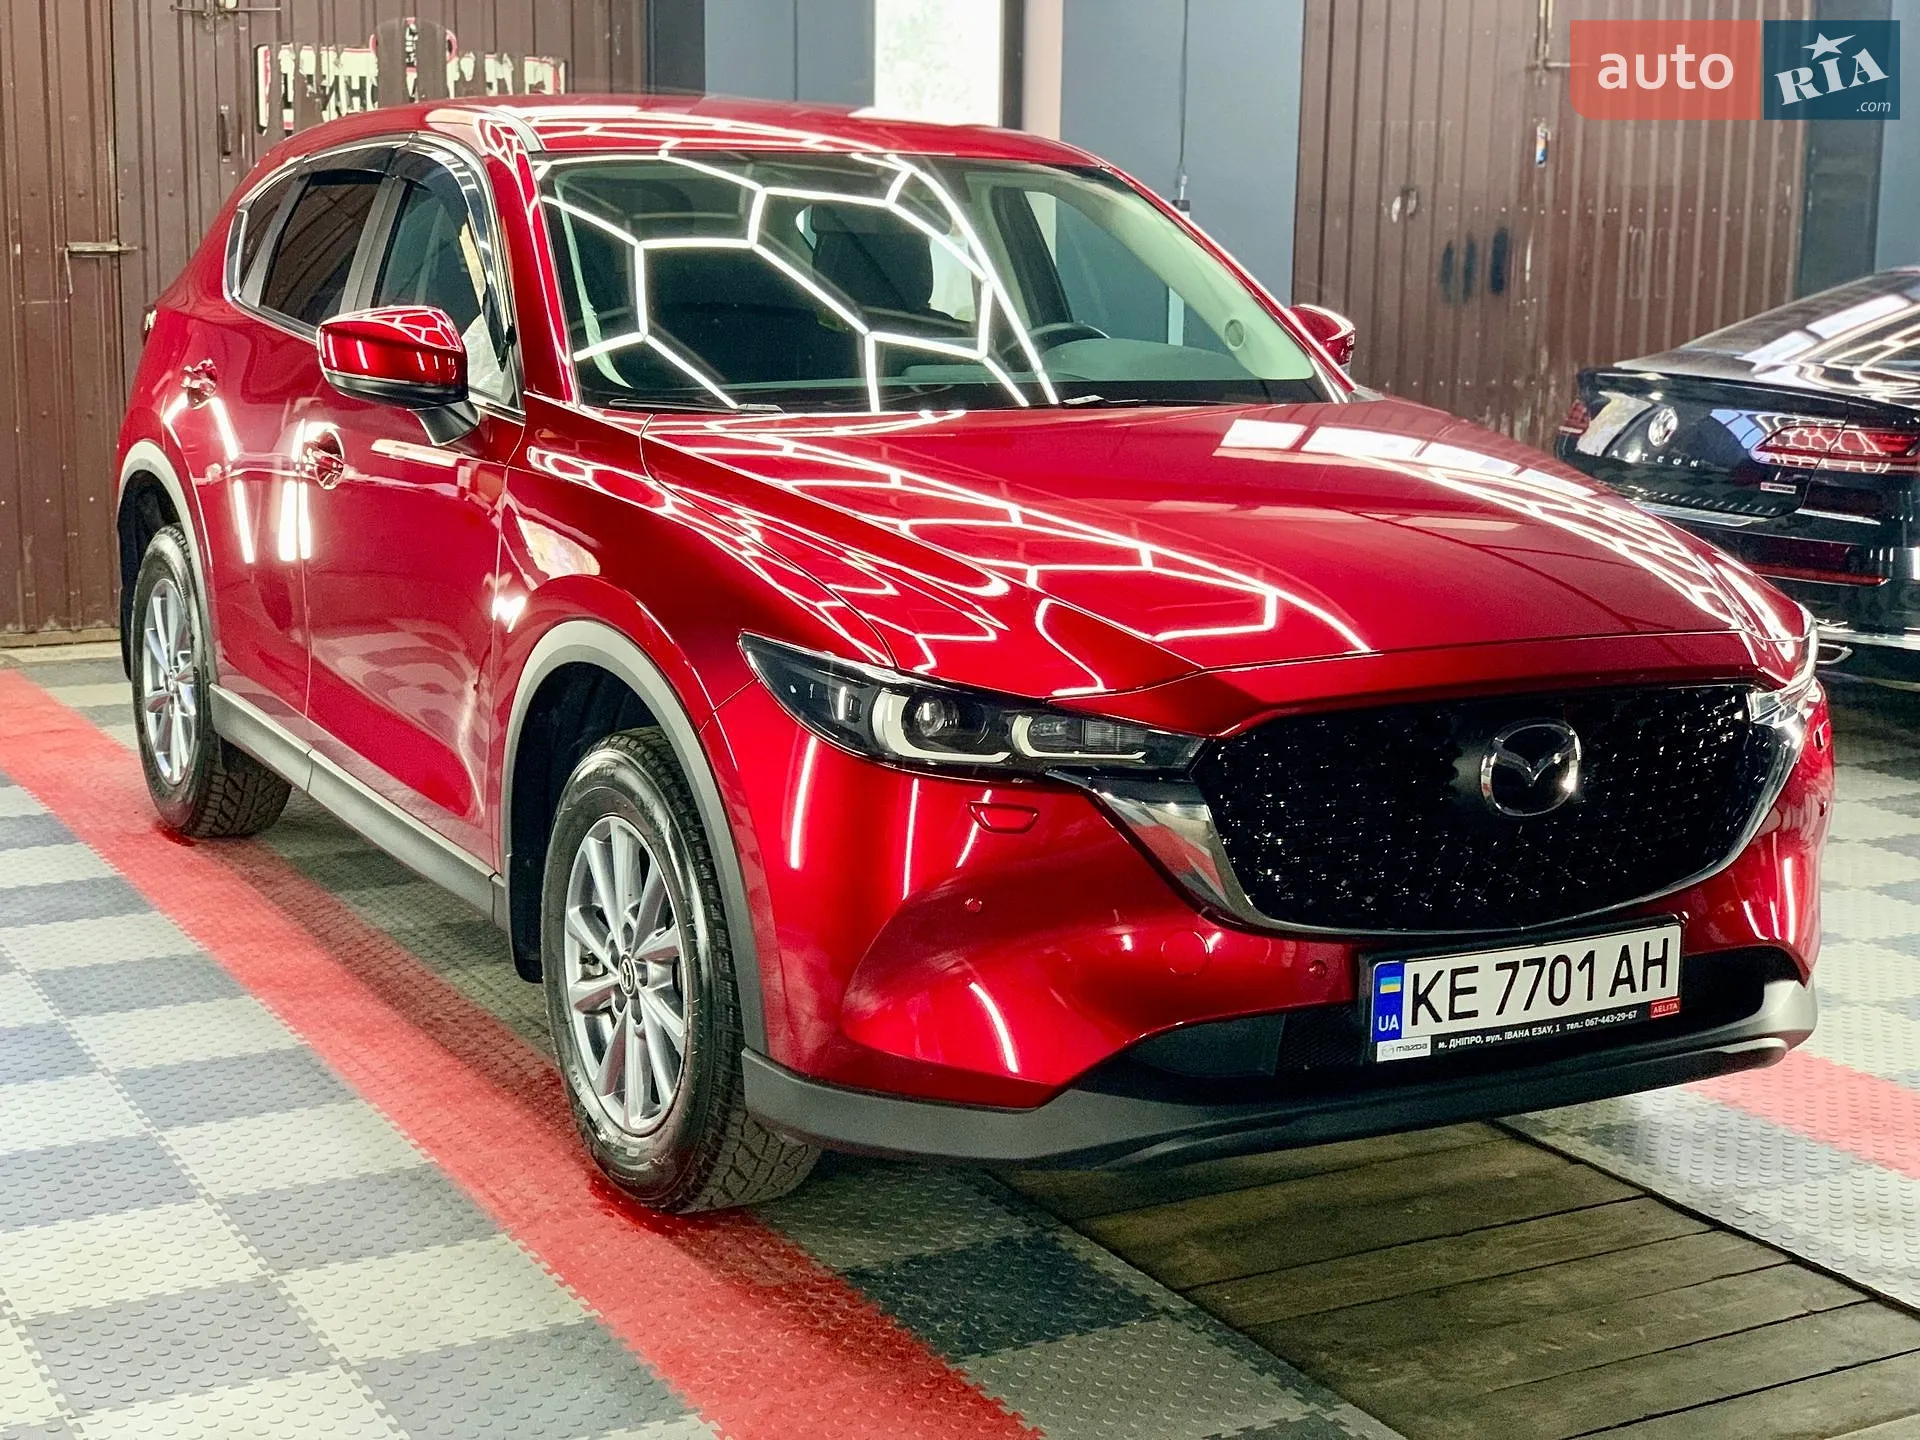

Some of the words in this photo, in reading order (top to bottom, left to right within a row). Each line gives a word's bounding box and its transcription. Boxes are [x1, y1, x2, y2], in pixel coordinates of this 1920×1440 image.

[1410, 965, 1480, 1027] KE
[1495, 949, 1596, 1016] 7701
[1608, 937, 1669, 998] AH
[1378, 1014, 1400, 1032] UA
[1395, 1042, 1428, 1053] mazda
[1448, 1035, 1484, 1049] ДНІПРО,
